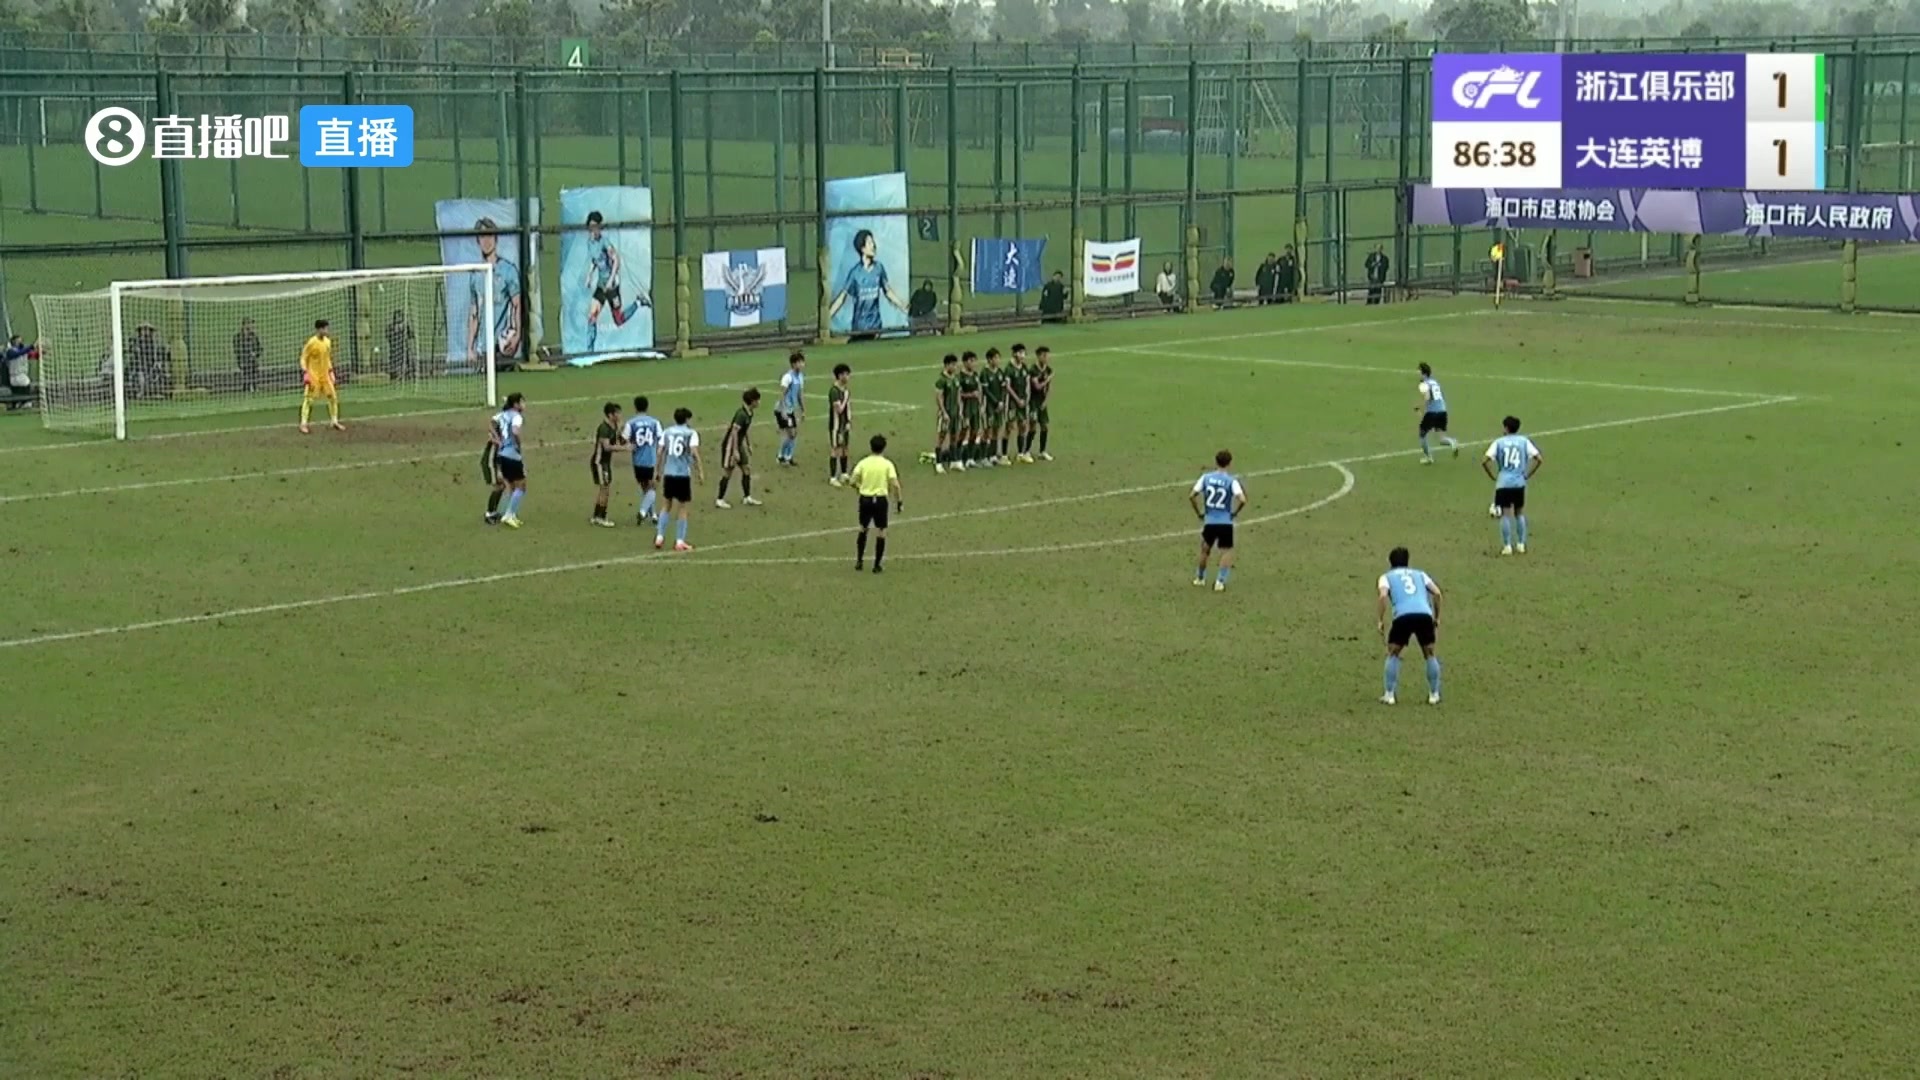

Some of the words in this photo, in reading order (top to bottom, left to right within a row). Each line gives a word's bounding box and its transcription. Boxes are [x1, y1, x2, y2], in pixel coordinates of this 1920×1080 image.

[568, 46, 582, 74] 4
[1485, 196, 1615, 222] 海口市足球协会
[1745, 202, 1894, 231] 海口市人民政府
[635, 427, 653, 446] 64
[668, 435, 685, 457] 16
[1503, 447, 1520, 468] 14
[1205, 485, 1227, 508] 22
[1400, 575, 1417, 595] 3
